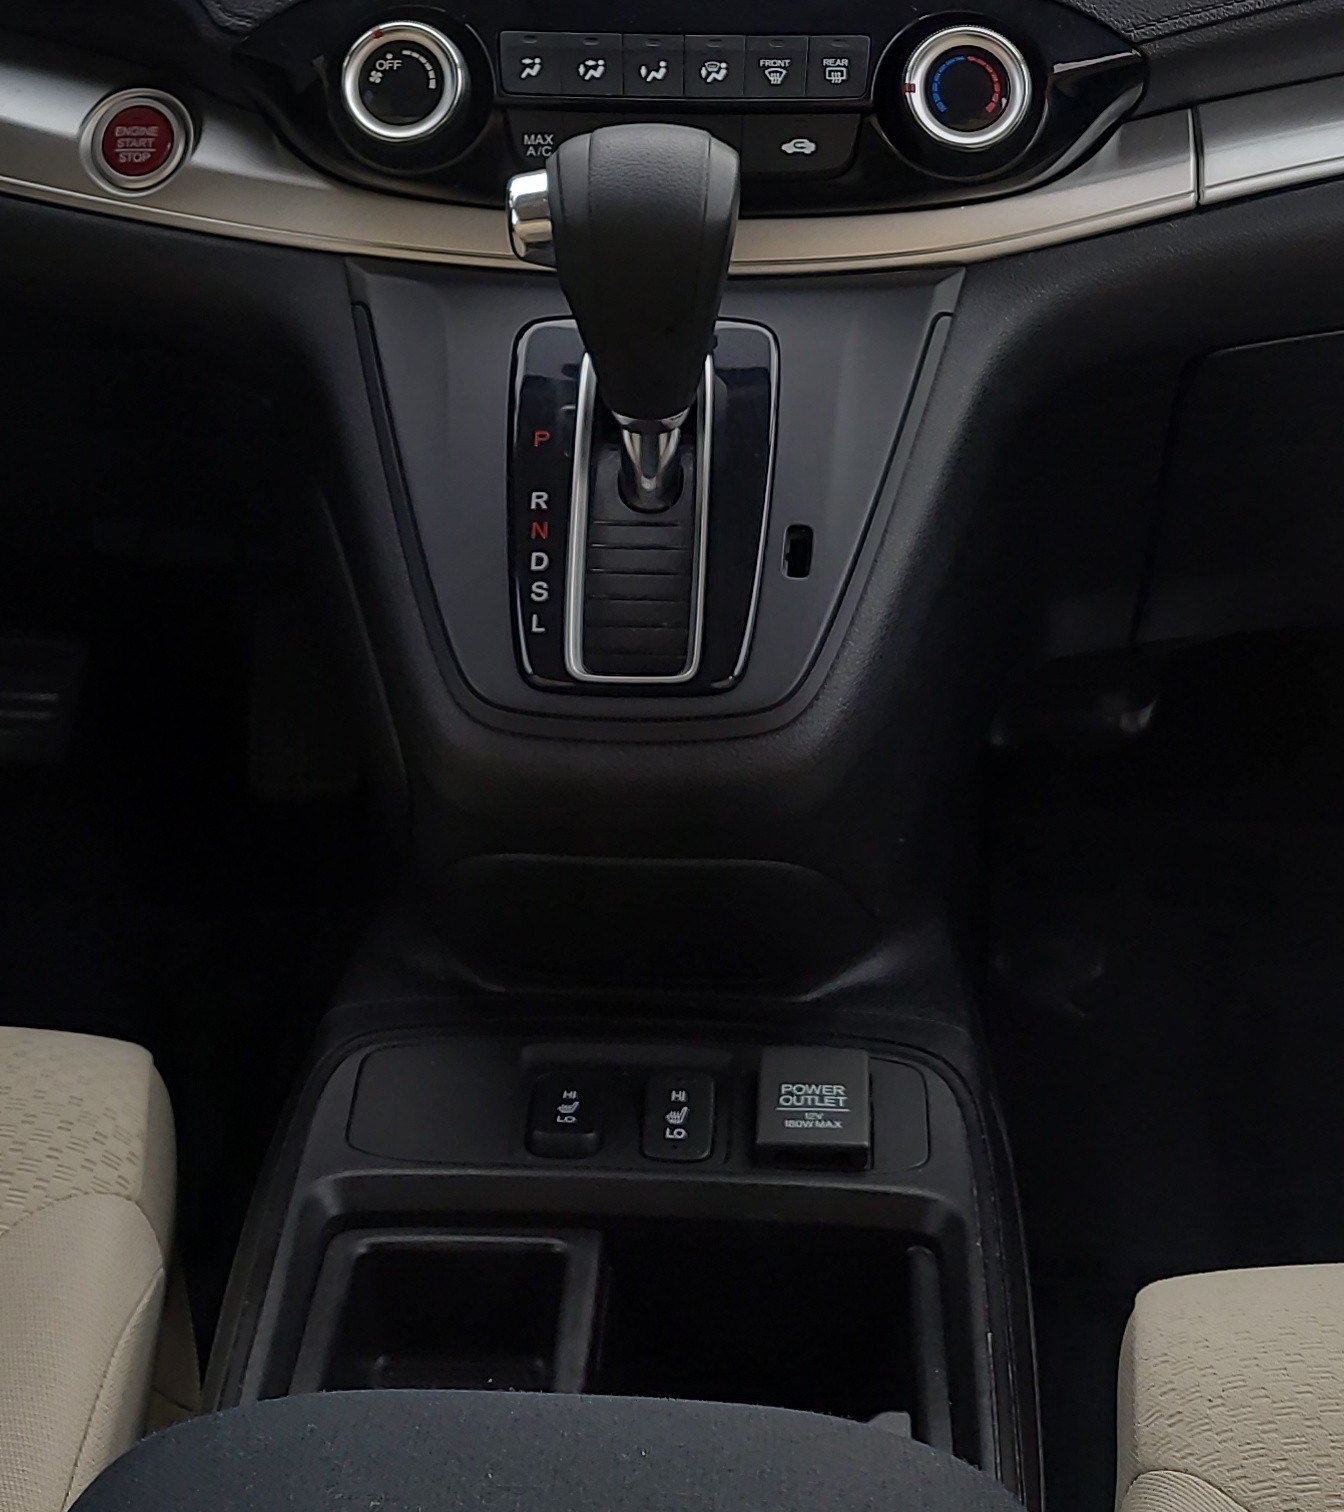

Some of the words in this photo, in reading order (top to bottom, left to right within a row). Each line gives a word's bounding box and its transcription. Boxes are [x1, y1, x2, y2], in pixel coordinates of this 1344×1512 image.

[375, 59, 403, 71] OFF
[759, 59, 791, 67] FRONT
[823, 58, 849, 66] REAR
[115, 126, 158, 137] ENGINE
[117, 137, 156, 148] START
[523, 134, 554, 145] MAX
[526, 145, 553, 157] A/C
[119, 152, 152, 163] STOP
[533, 430, 551, 447] P
[530, 491, 548, 510] R
[531, 521, 548, 539] N
[530, 552, 549, 571] D
[530, 581, 549, 602] S
[531, 614, 546, 633] L
[562, 1090, 578, 1099] HI
[781, 1083, 847, 1096] POWER
[671, 1090, 687, 1102] HI
[779, 1095, 849, 1107] OUTLET
[556, 1115, 578, 1124] LO
[665, 1127, 688, 1139] LO
